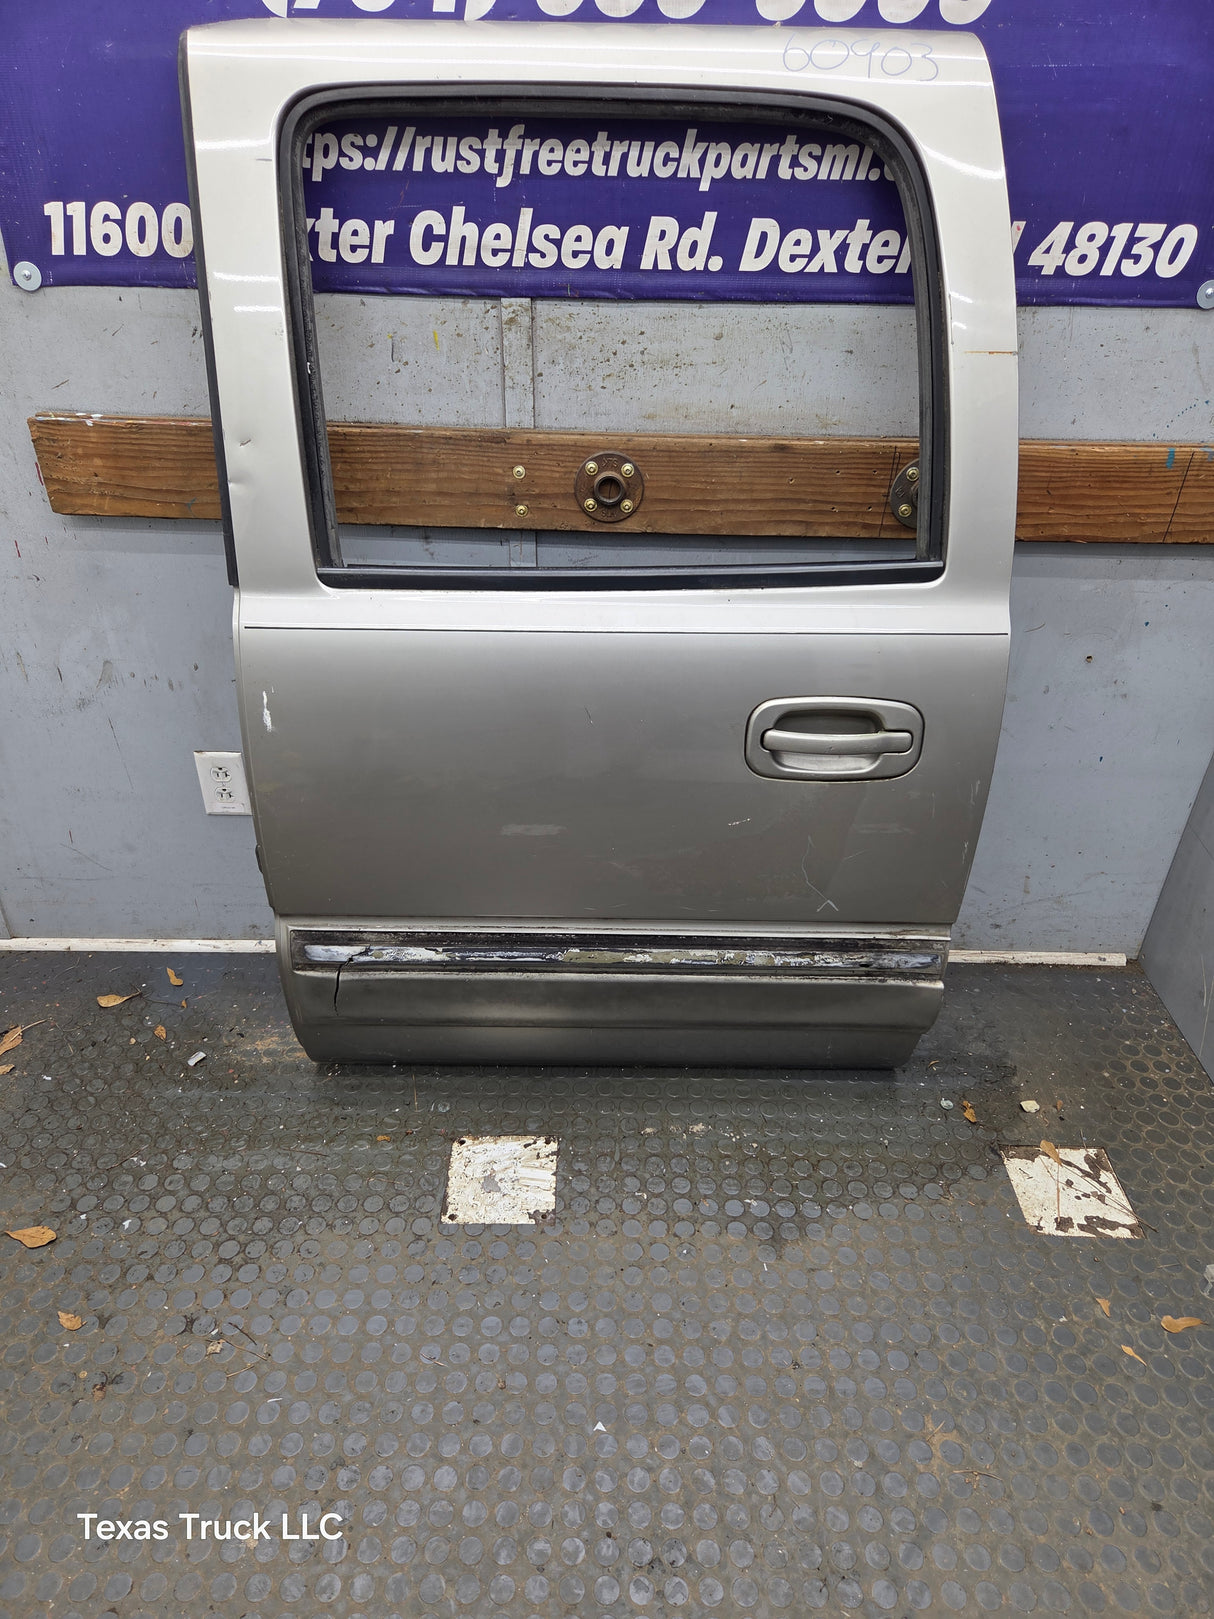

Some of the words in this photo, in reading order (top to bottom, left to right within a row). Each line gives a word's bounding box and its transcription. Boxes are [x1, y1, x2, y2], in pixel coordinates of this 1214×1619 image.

[782, 32, 939, 82] 60903
[43, 200, 195, 259] 11600
[409, 205, 629, 270] Chelsea
[639, 211, 723, 272] Rd.
[1027, 220, 1199, 279] 48130
